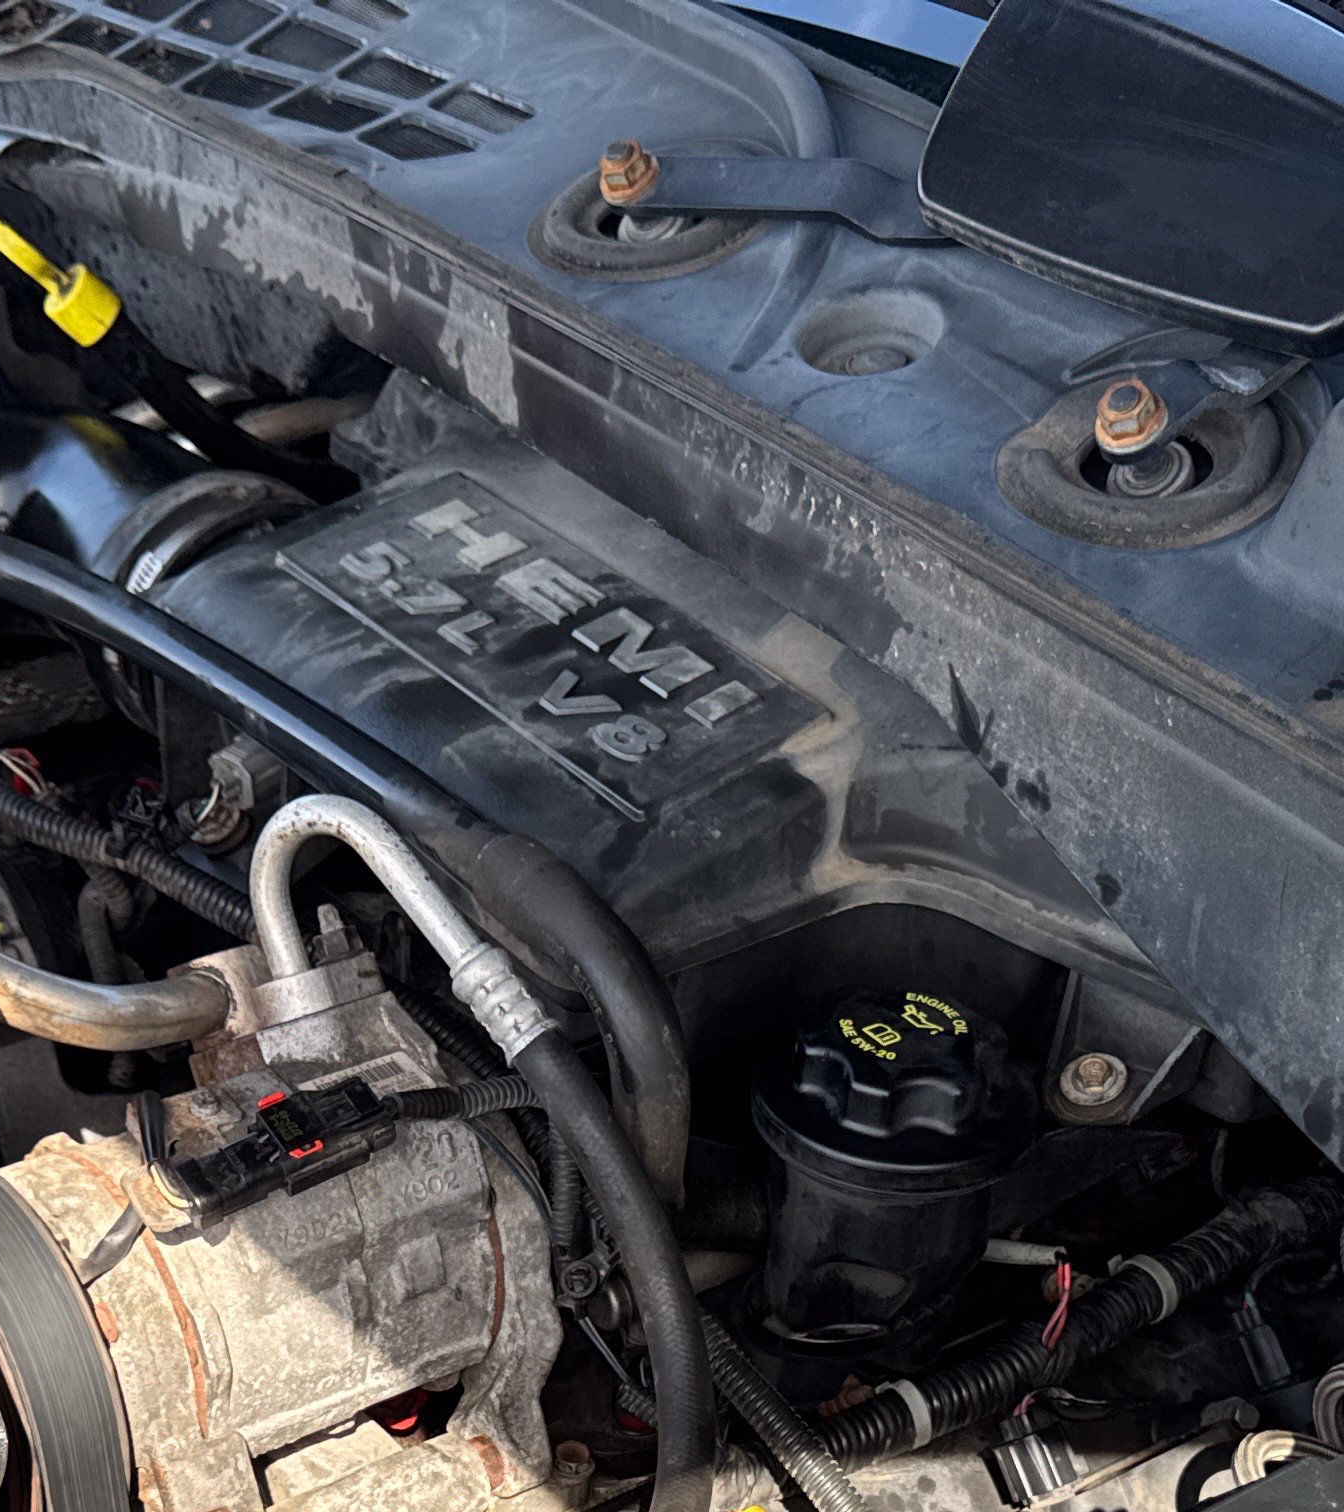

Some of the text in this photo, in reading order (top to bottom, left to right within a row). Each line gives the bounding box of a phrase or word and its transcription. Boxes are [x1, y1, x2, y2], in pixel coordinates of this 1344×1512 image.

[339, 541, 671, 763] 5.7L V8
[408, 498, 762, 729] HEMI
[838, 1018, 897, 1061] SAE 5W-20
[905, 992, 969, 1036] ENGINE OIL
